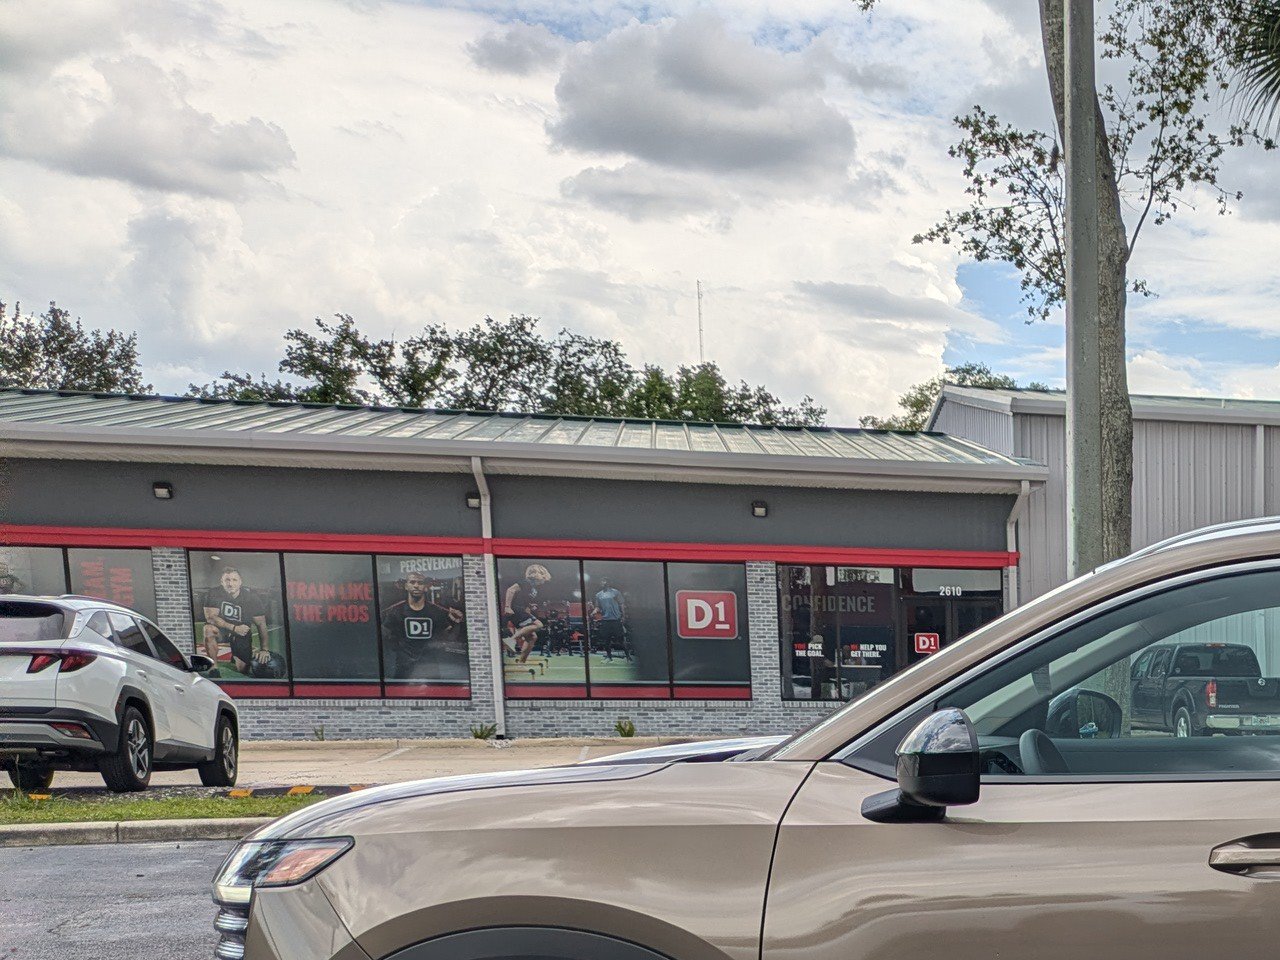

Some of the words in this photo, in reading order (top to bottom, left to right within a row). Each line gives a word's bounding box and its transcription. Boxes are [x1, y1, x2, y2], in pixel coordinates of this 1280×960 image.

[287, 582, 335, 600] TRAIN
[339, 582, 373, 600] LIKE
[939, 586, 962, 596] 2610
[224, 604, 239, 619] D1
[782, 595, 875, 613] CONFIDENCE
[293, 604, 322, 622] THE
[326, 604, 370, 623] PROS
[686, 598, 730, 630] D1
[409, 621, 431, 635] D1
[919, 636, 936, 649] D1
